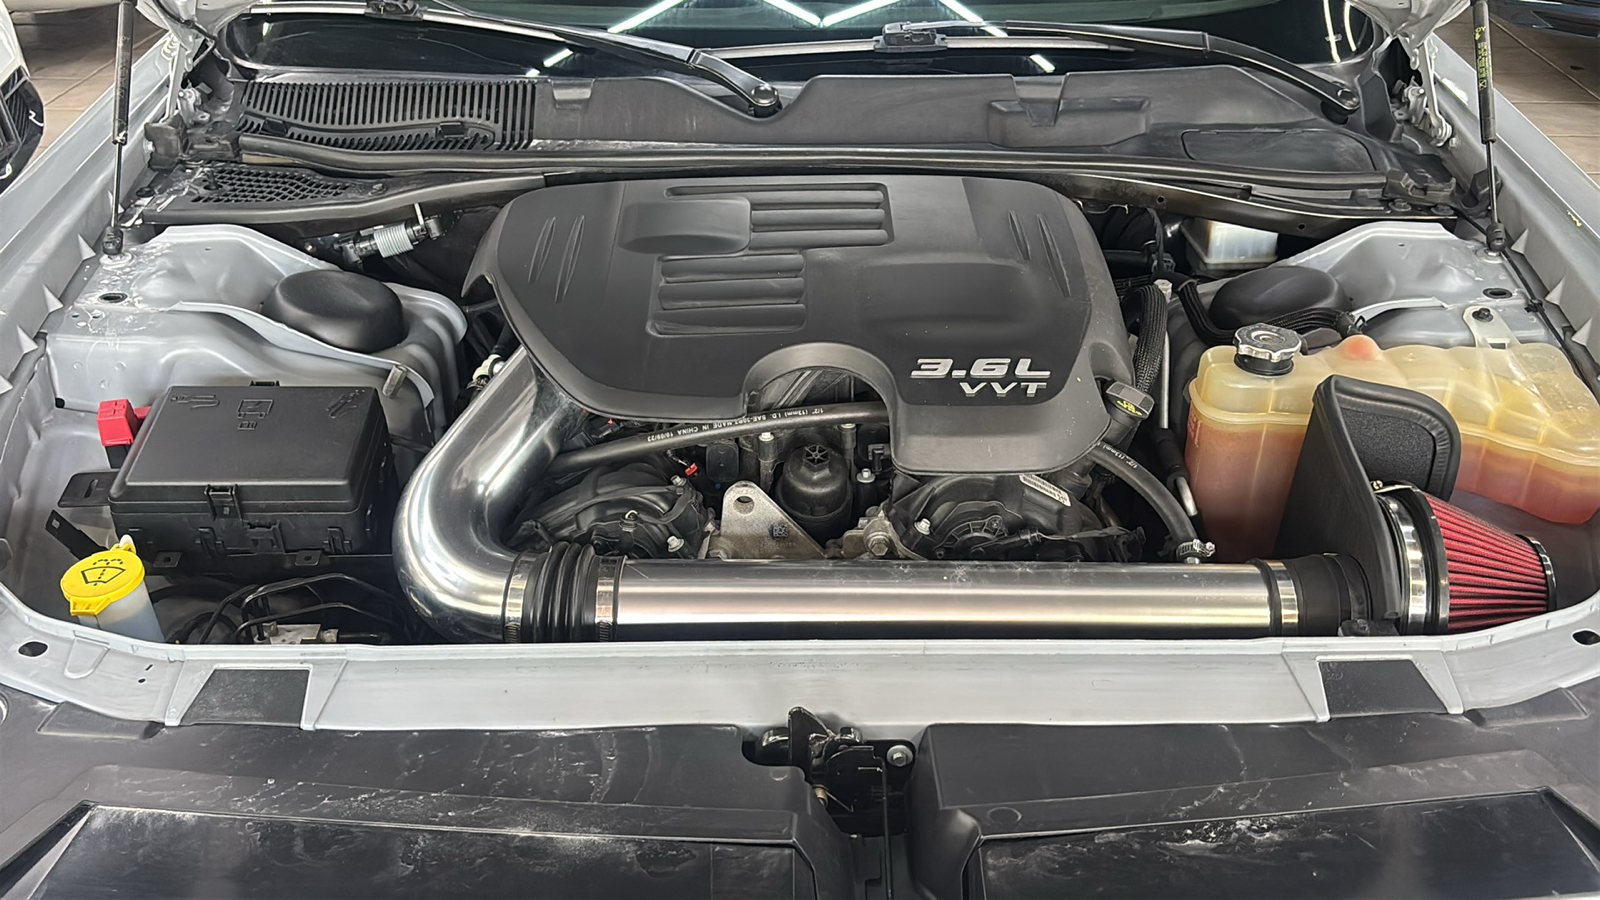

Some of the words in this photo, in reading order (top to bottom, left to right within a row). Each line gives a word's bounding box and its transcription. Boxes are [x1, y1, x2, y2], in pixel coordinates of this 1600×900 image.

[910, 358, 1051, 378] 3.6L
[959, 381, 1048, 397] VVT
[677, 426, 699, 436] CHINA
[712, 421, 733, 429] MADE
